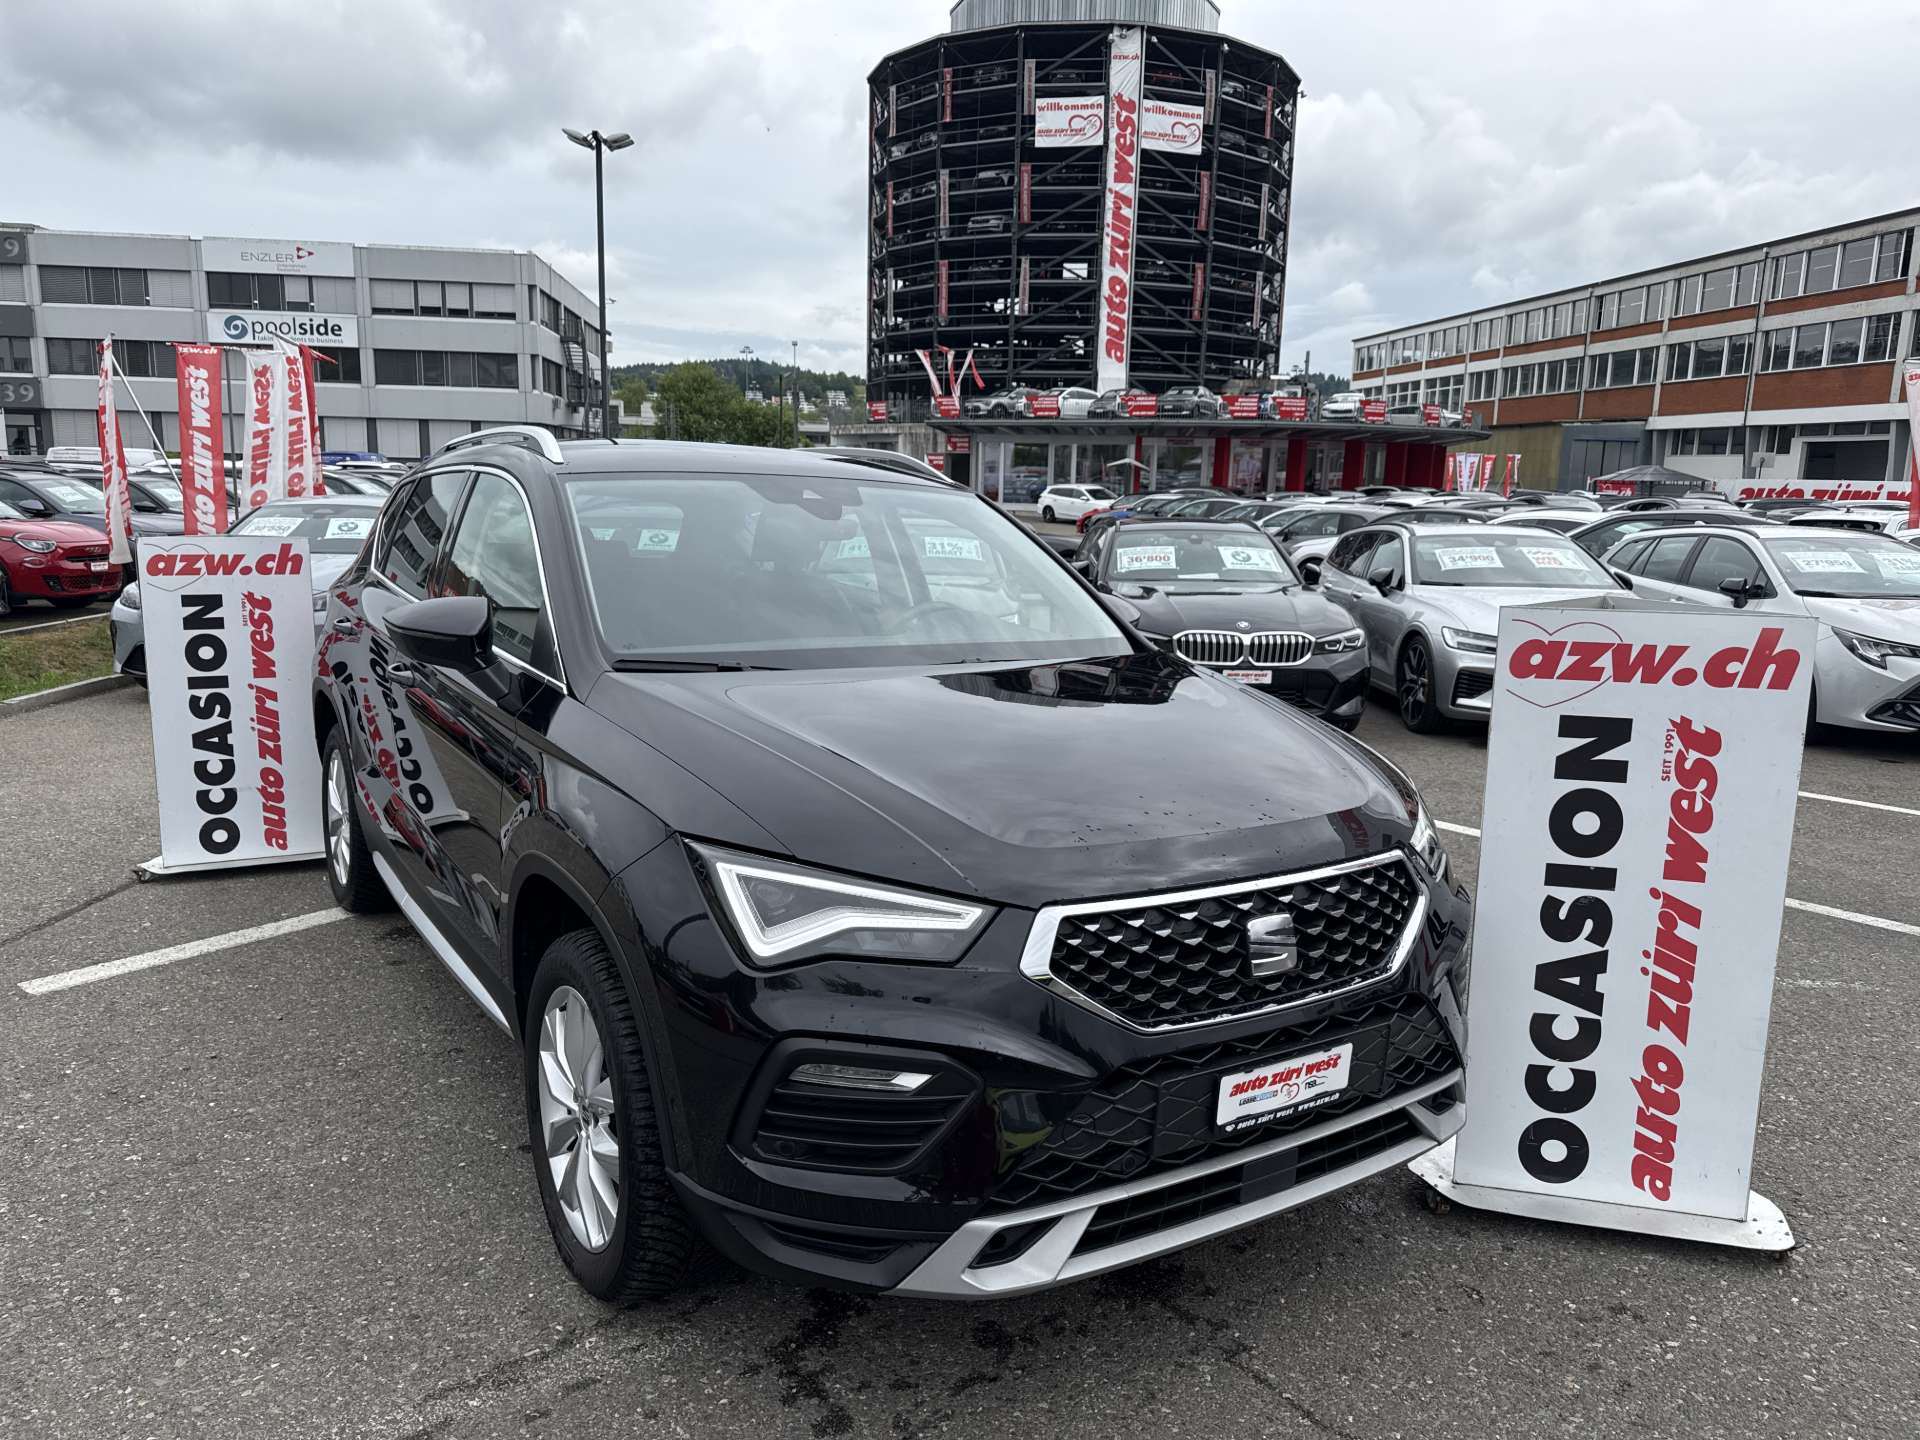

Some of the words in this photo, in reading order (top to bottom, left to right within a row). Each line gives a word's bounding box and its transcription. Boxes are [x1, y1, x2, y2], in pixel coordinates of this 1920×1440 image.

[1037, 102, 1103, 112] willkommen
[1110, 91, 1137, 184] west
[1144, 105, 1202, 119] willkommen
[240, 251, 295, 263] ENZLER
[1106, 187, 1133, 271] züri
[251, 316, 343, 341] poolside
[316, 336, 344, 344] business
[1104, 275, 1127, 363] auto
[1, 382, 34, 402] 39
[188, 364, 213, 428] west
[189, 430, 215, 492] züri
[146, 543, 304, 576] azw.ch
[242, 590, 275, 681] west
[1508, 627, 1801, 691] azw.ch
[181, 593, 241, 855] OCCASION
[248, 683, 283, 766] züri
[1663, 727, 1675, 755] 1991
[1660, 758, 1672, 782] SEIT
[1662, 715, 1724, 884] west
[256, 767, 288, 852] auto
[1517, 713, 1634, 1185] OCCASION
[1640, 886, 1703, 1047] züri
[1229, 1074, 1269, 1098] auto
[1268, 1062, 1304, 1087] züri
[1304, 1055, 1342, 1077] west
[1236, 1119, 1256, 1130] auto
[1257, 1112, 1275, 1124] züri
[1275, 1107, 1295, 1118] west
[1628, 1044, 1685, 1203] auto
